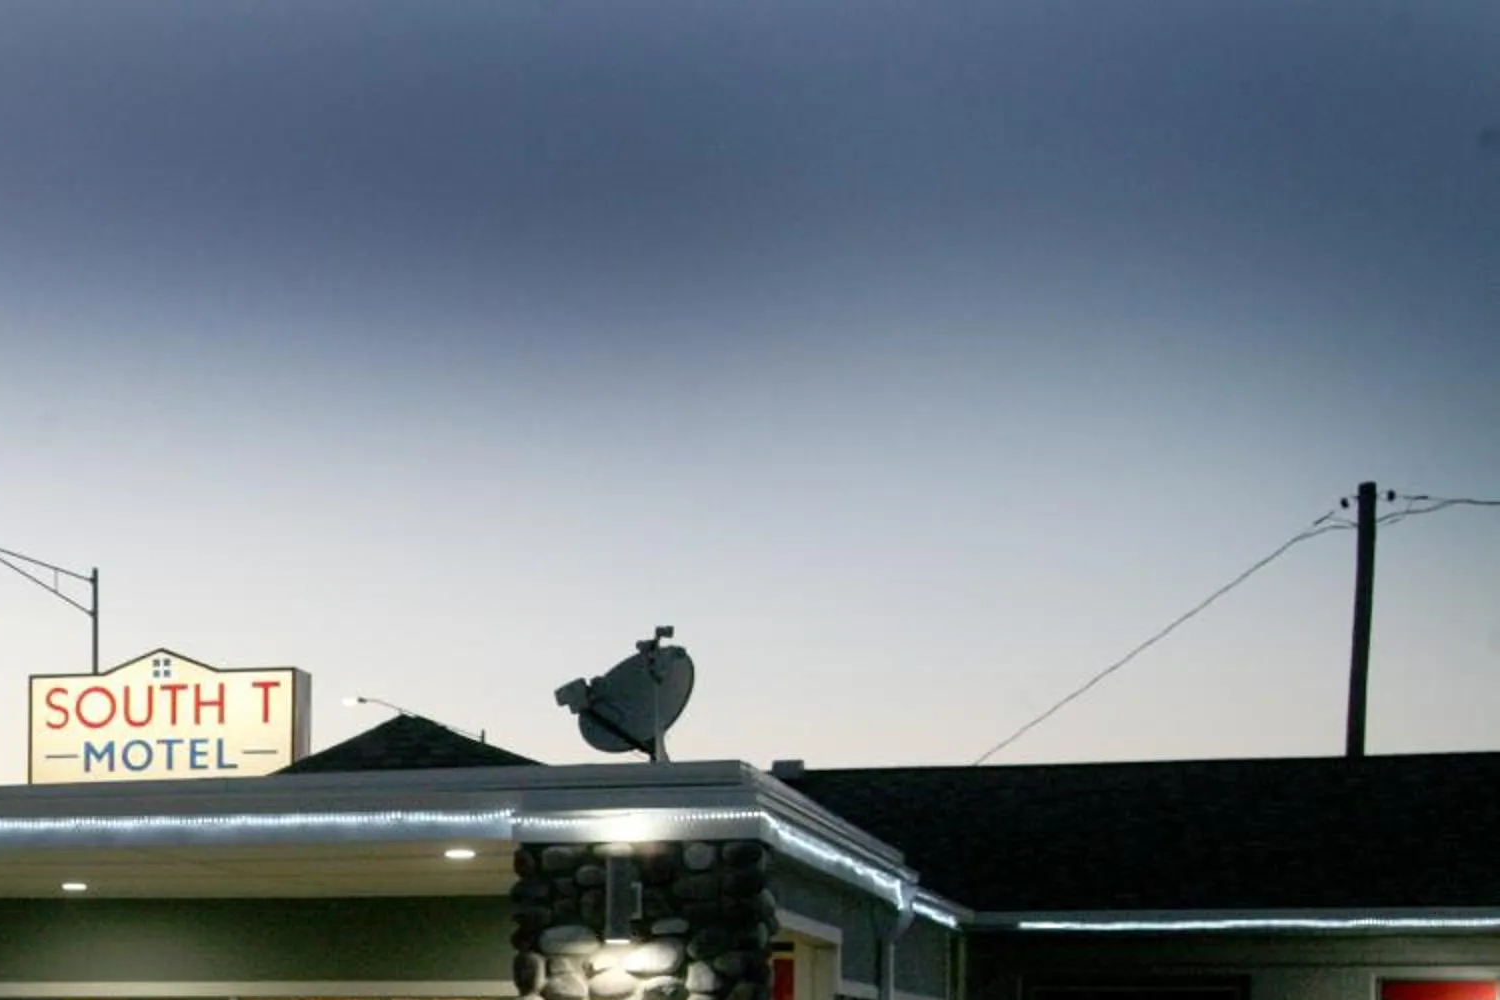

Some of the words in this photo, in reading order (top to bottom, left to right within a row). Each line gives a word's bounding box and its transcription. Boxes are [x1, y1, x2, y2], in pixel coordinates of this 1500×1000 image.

[45, 682, 226, 730] SOUTH
[251, 681, 281, 724] T
[83, 738, 239, 773] MOTEL
